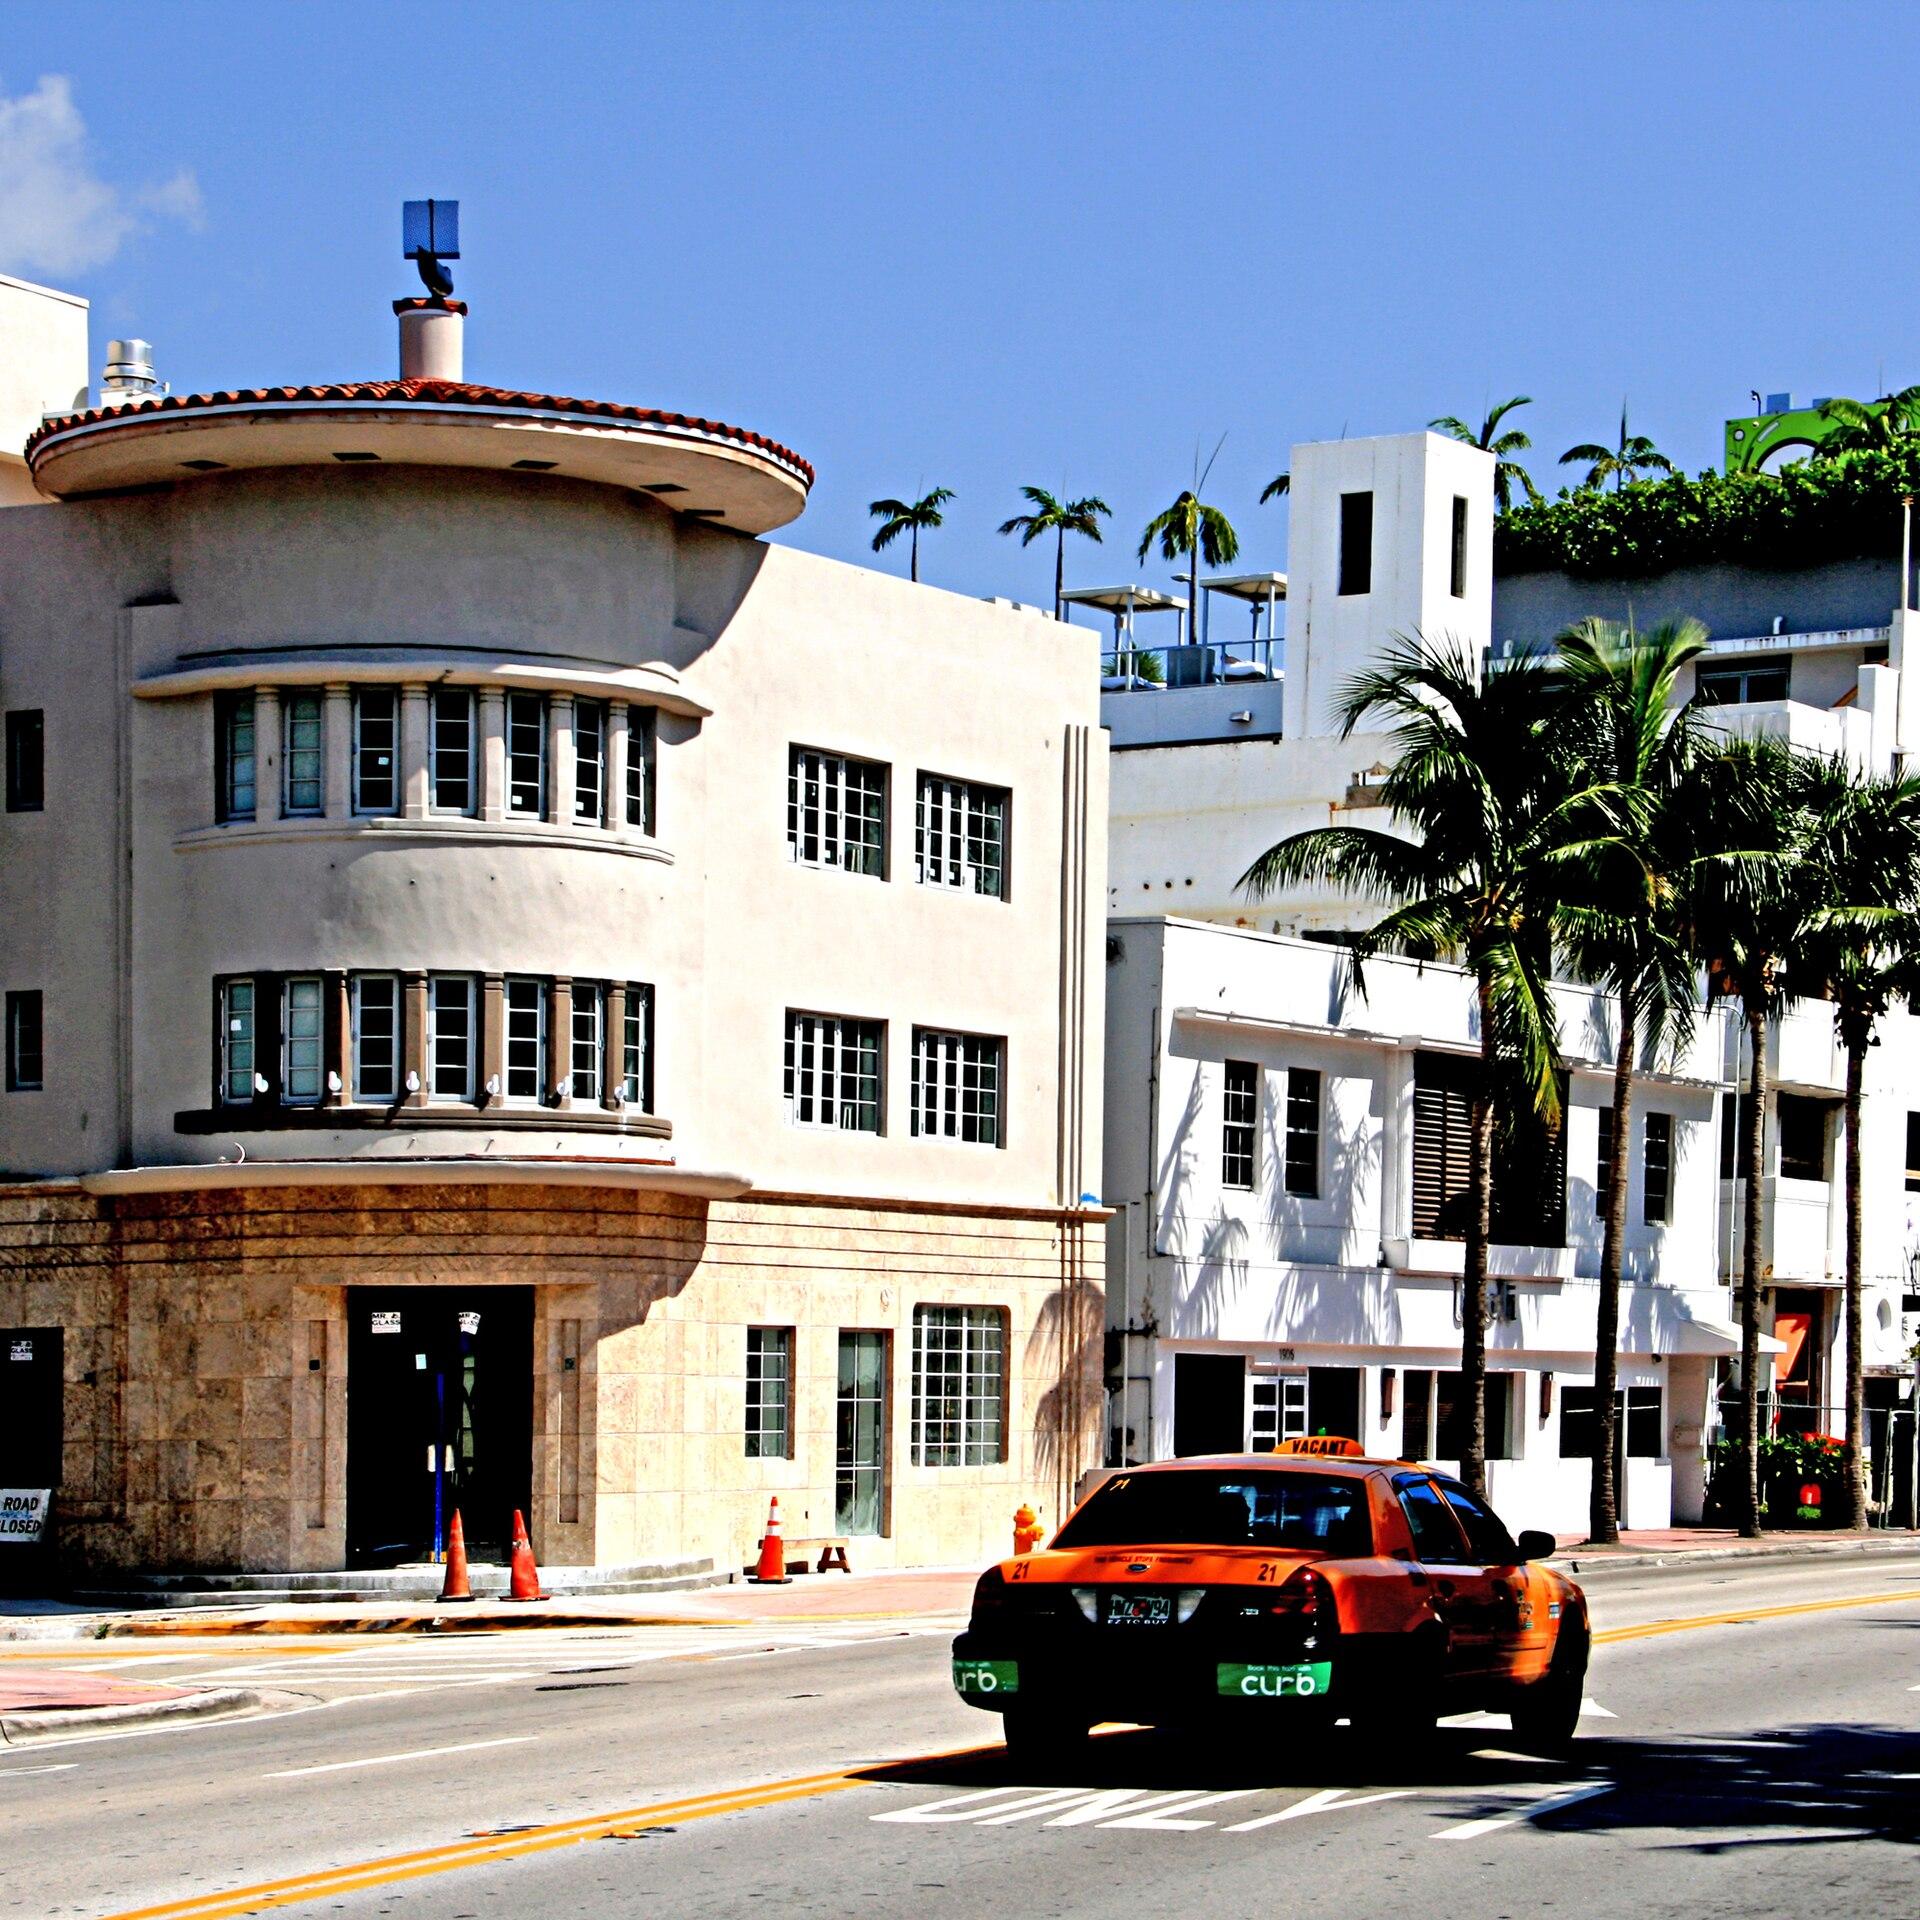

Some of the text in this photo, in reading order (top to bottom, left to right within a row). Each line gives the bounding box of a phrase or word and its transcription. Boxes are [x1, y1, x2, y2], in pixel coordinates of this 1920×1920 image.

[1292, 1440, 1348, 1456] VACANT
[4, 1497, 39, 1511] ROAD
[0, 1519, 42, 1534] LOSED
[1011, 1561, 1029, 1580] 21
[1257, 1563, 1277, 1582] 21
[954, 1668, 998, 1693] urb
[1240, 1672, 1316, 1696] curb
[868, 1786, 1418, 1832] ONLY
